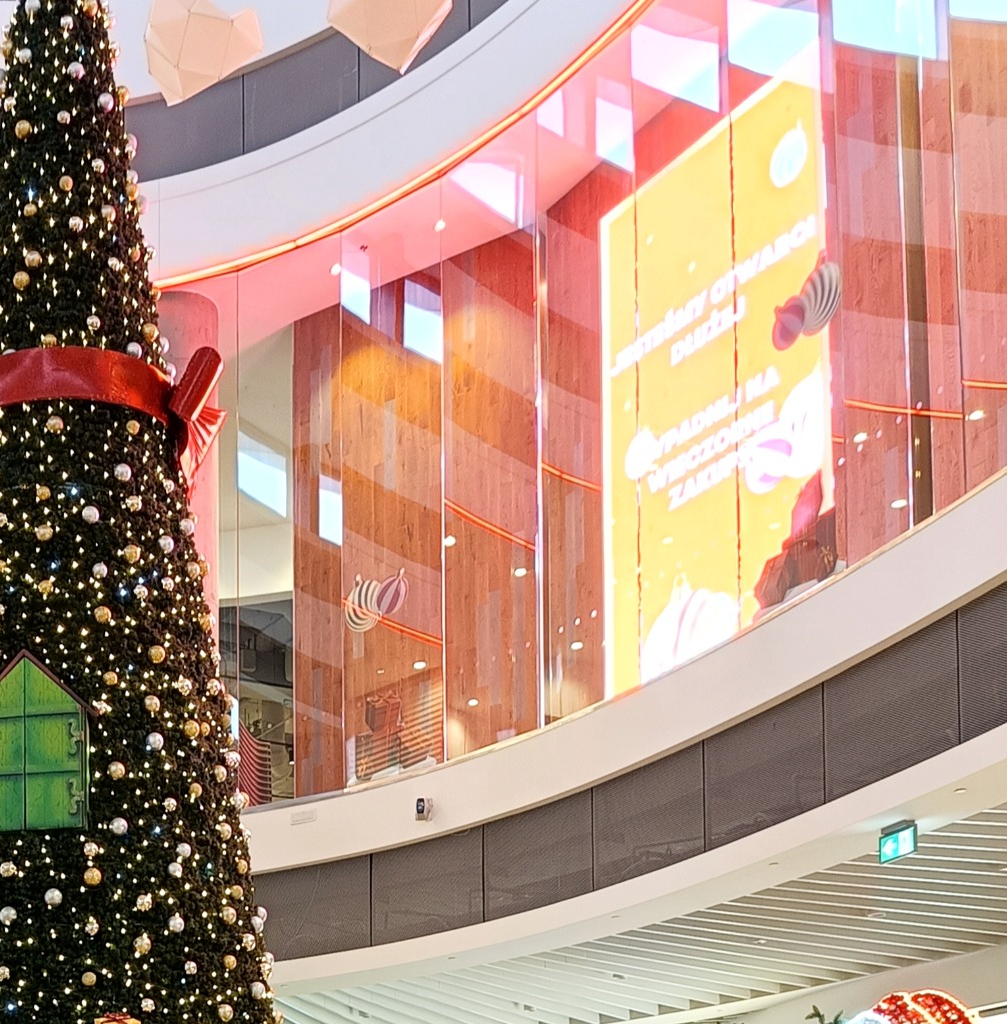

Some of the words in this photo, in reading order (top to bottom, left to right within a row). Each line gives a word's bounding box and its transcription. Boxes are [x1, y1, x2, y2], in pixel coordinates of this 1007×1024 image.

[710, 214, 816, 305] OTWARCI
[670, 295, 746, 367] DŁUŻEJ
[745, 365, 780, 403] NA
